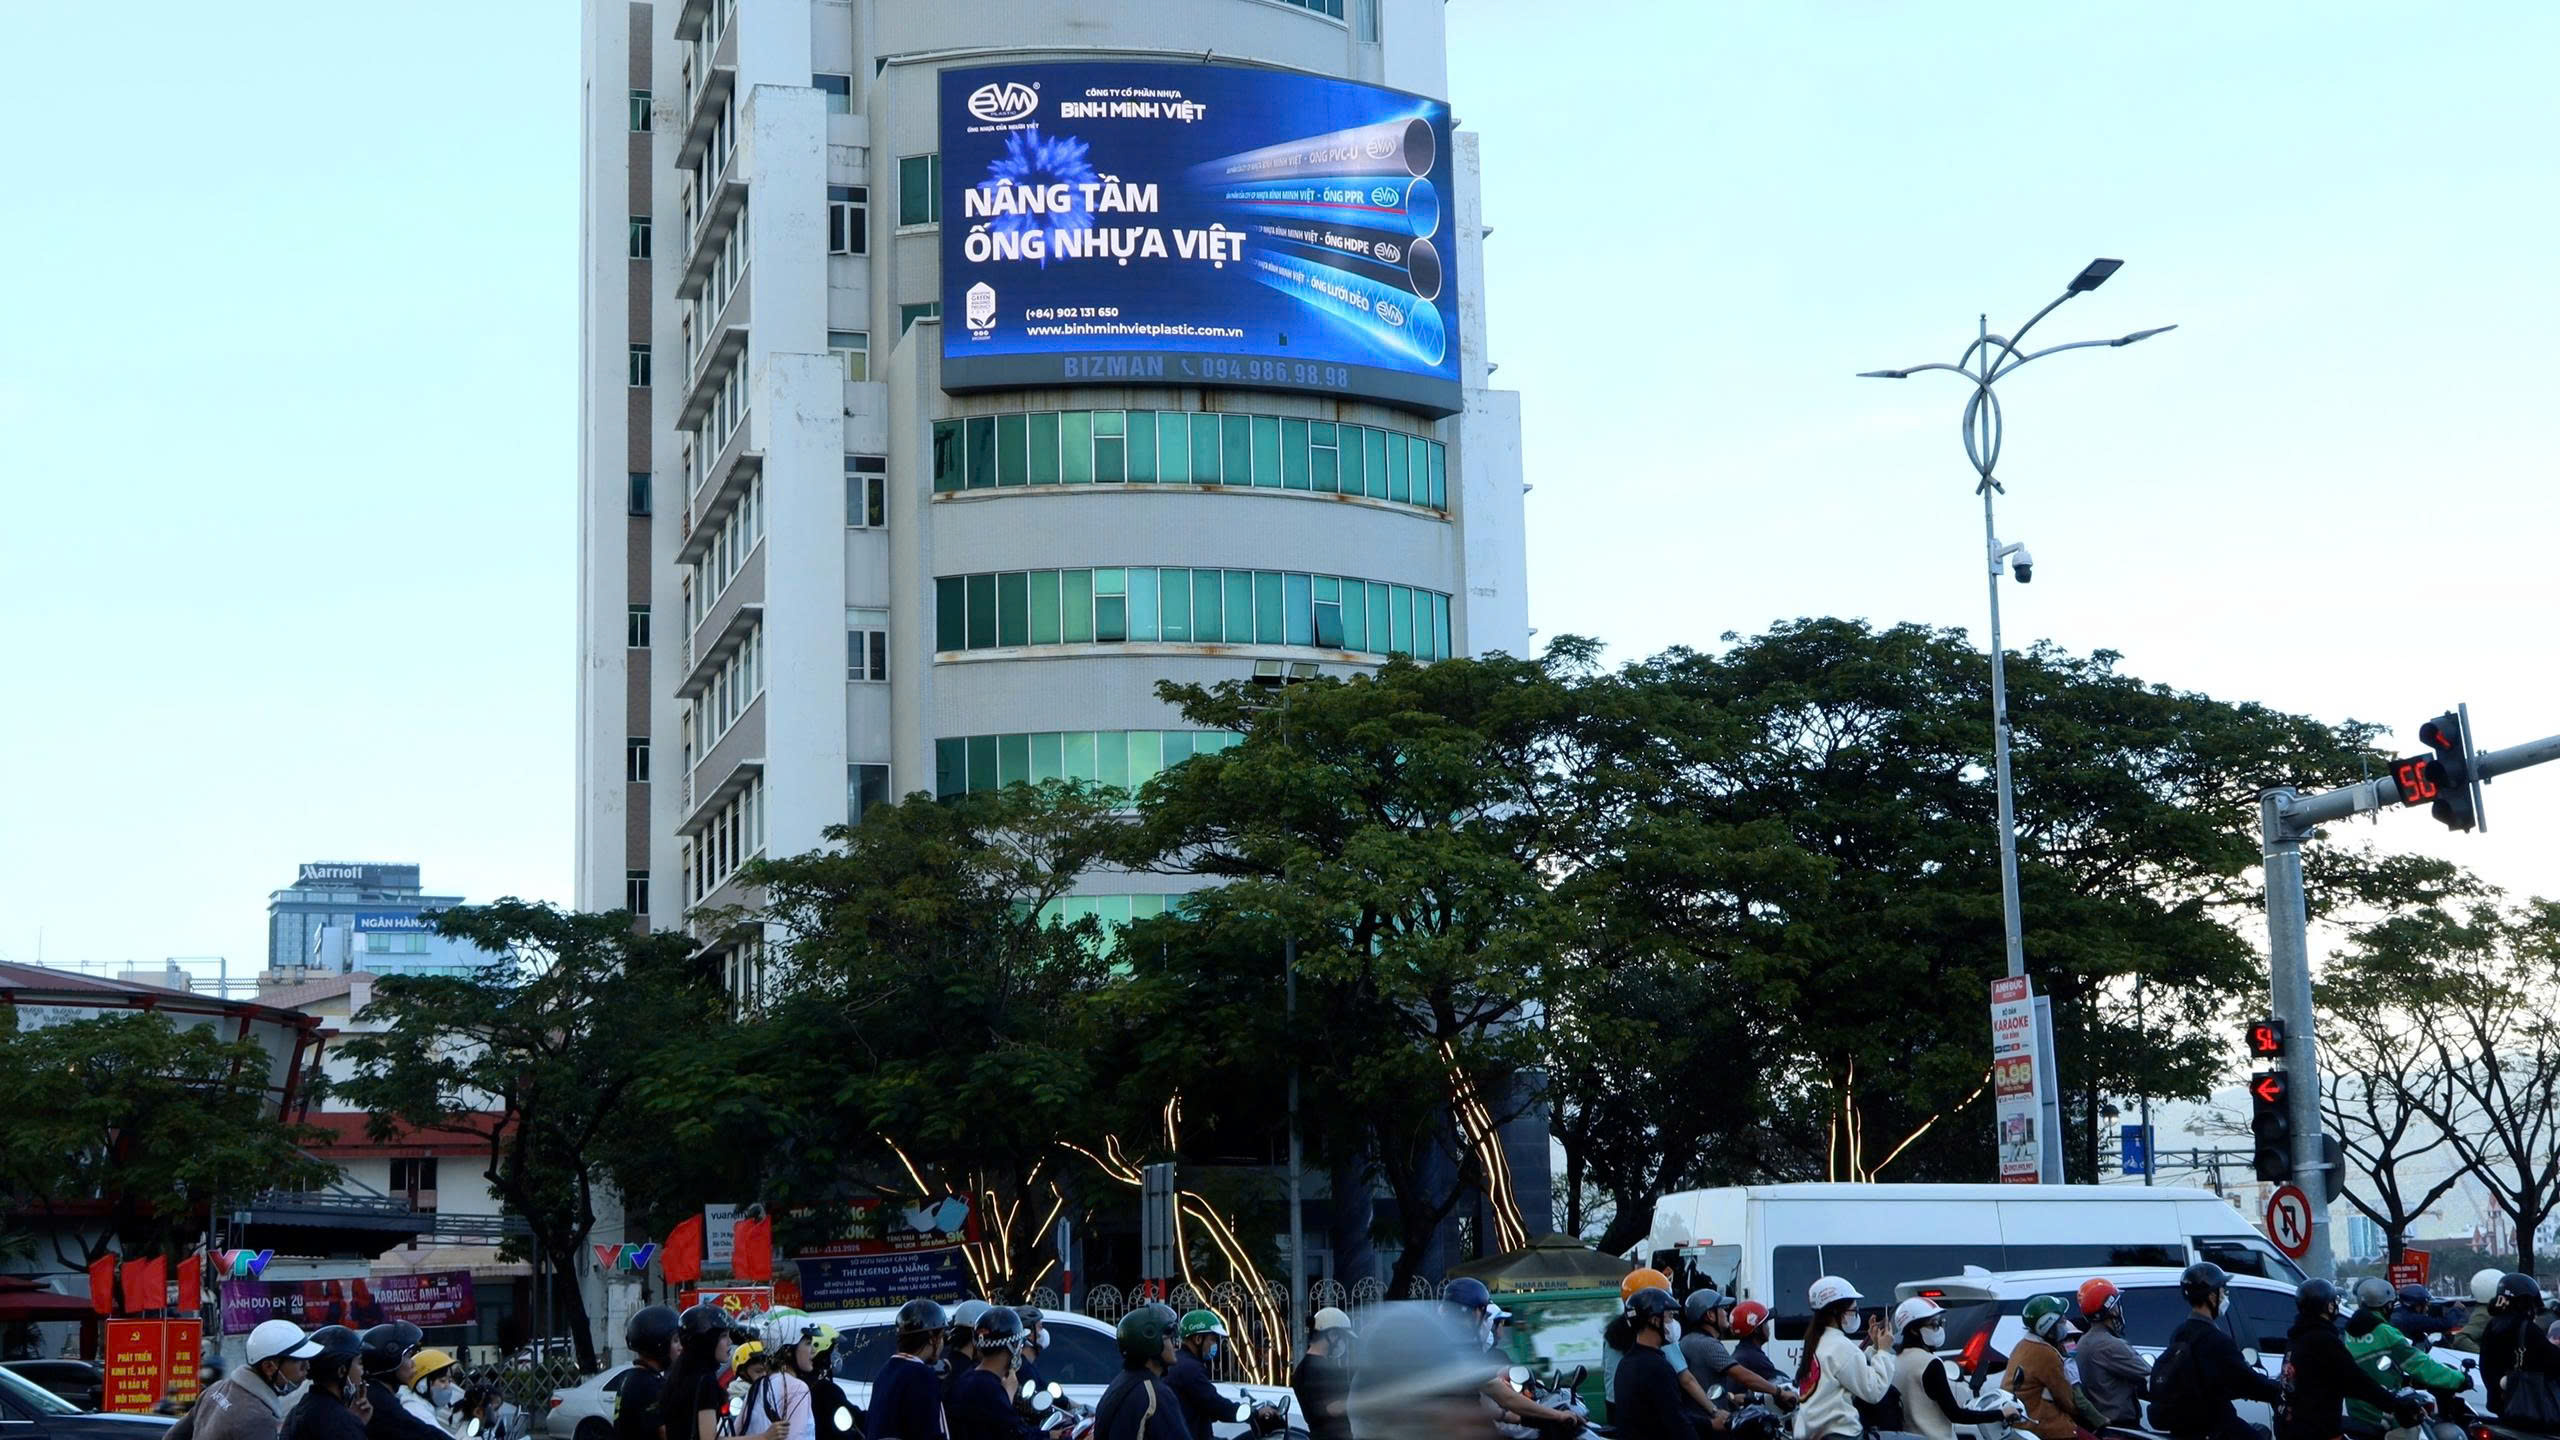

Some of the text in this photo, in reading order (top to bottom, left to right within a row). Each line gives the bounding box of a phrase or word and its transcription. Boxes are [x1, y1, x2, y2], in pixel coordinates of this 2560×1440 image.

[1085, 87, 1109, 98] CÔNG
[1109, 89, 1120, 98] TY
[1133, 86, 1156, 98] PHẦN
[1156, 89, 1182, 100] NHỰA
[1162, 100, 1206, 124] VIỆT
[965, 173, 1158, 218] NÂNG TẦM
[1323, 186, 1344, 203] ỐNG
[1344, 190, 1364, 204] PPR
[964, 222, 1247, 269] ỐNG NHỰA VIỆT
[1304, 229, 1319, 245] VIỆT
[1324, 232, 1343, 248] ỐNG
[1344, 239, 1370, 255] HDPE
[1025, 307, 1119, 321] (+84) 902 131 650
[1027, 322, 1243, 338] www.binhminhvietplastic.com.vn
[1064, 356, 1348, 388] BIZMAN 094.986.98.98
[300, 865, 363, 880] Marriott
[361, 915, 394, 928] NGÂN
[1994, 1016, 2029, 1032] KARAOKE
[946, 1231, 966, 1243] 9K
[208, 1249, 275, 1276] VTV
[594, 1243, 657, 1270] VTV
[842, 1269, 857, 1277] THE
[859, 1266, 890, 1276] LEGEND
[1515, 1280, 1536, 1288] NAM
[1544, 1280, 1569, 1288] BANK
[228, 1297, 250, 1309] ANH
[291, 1294, 303, 1307] 20
[374, 1288, 418, 1304] KARAOKE
[842, 1298, 866, 1308] 0935
[868, 1296, 886, 1306] 681
[1189, 1322, 1206, 1331] Grab
